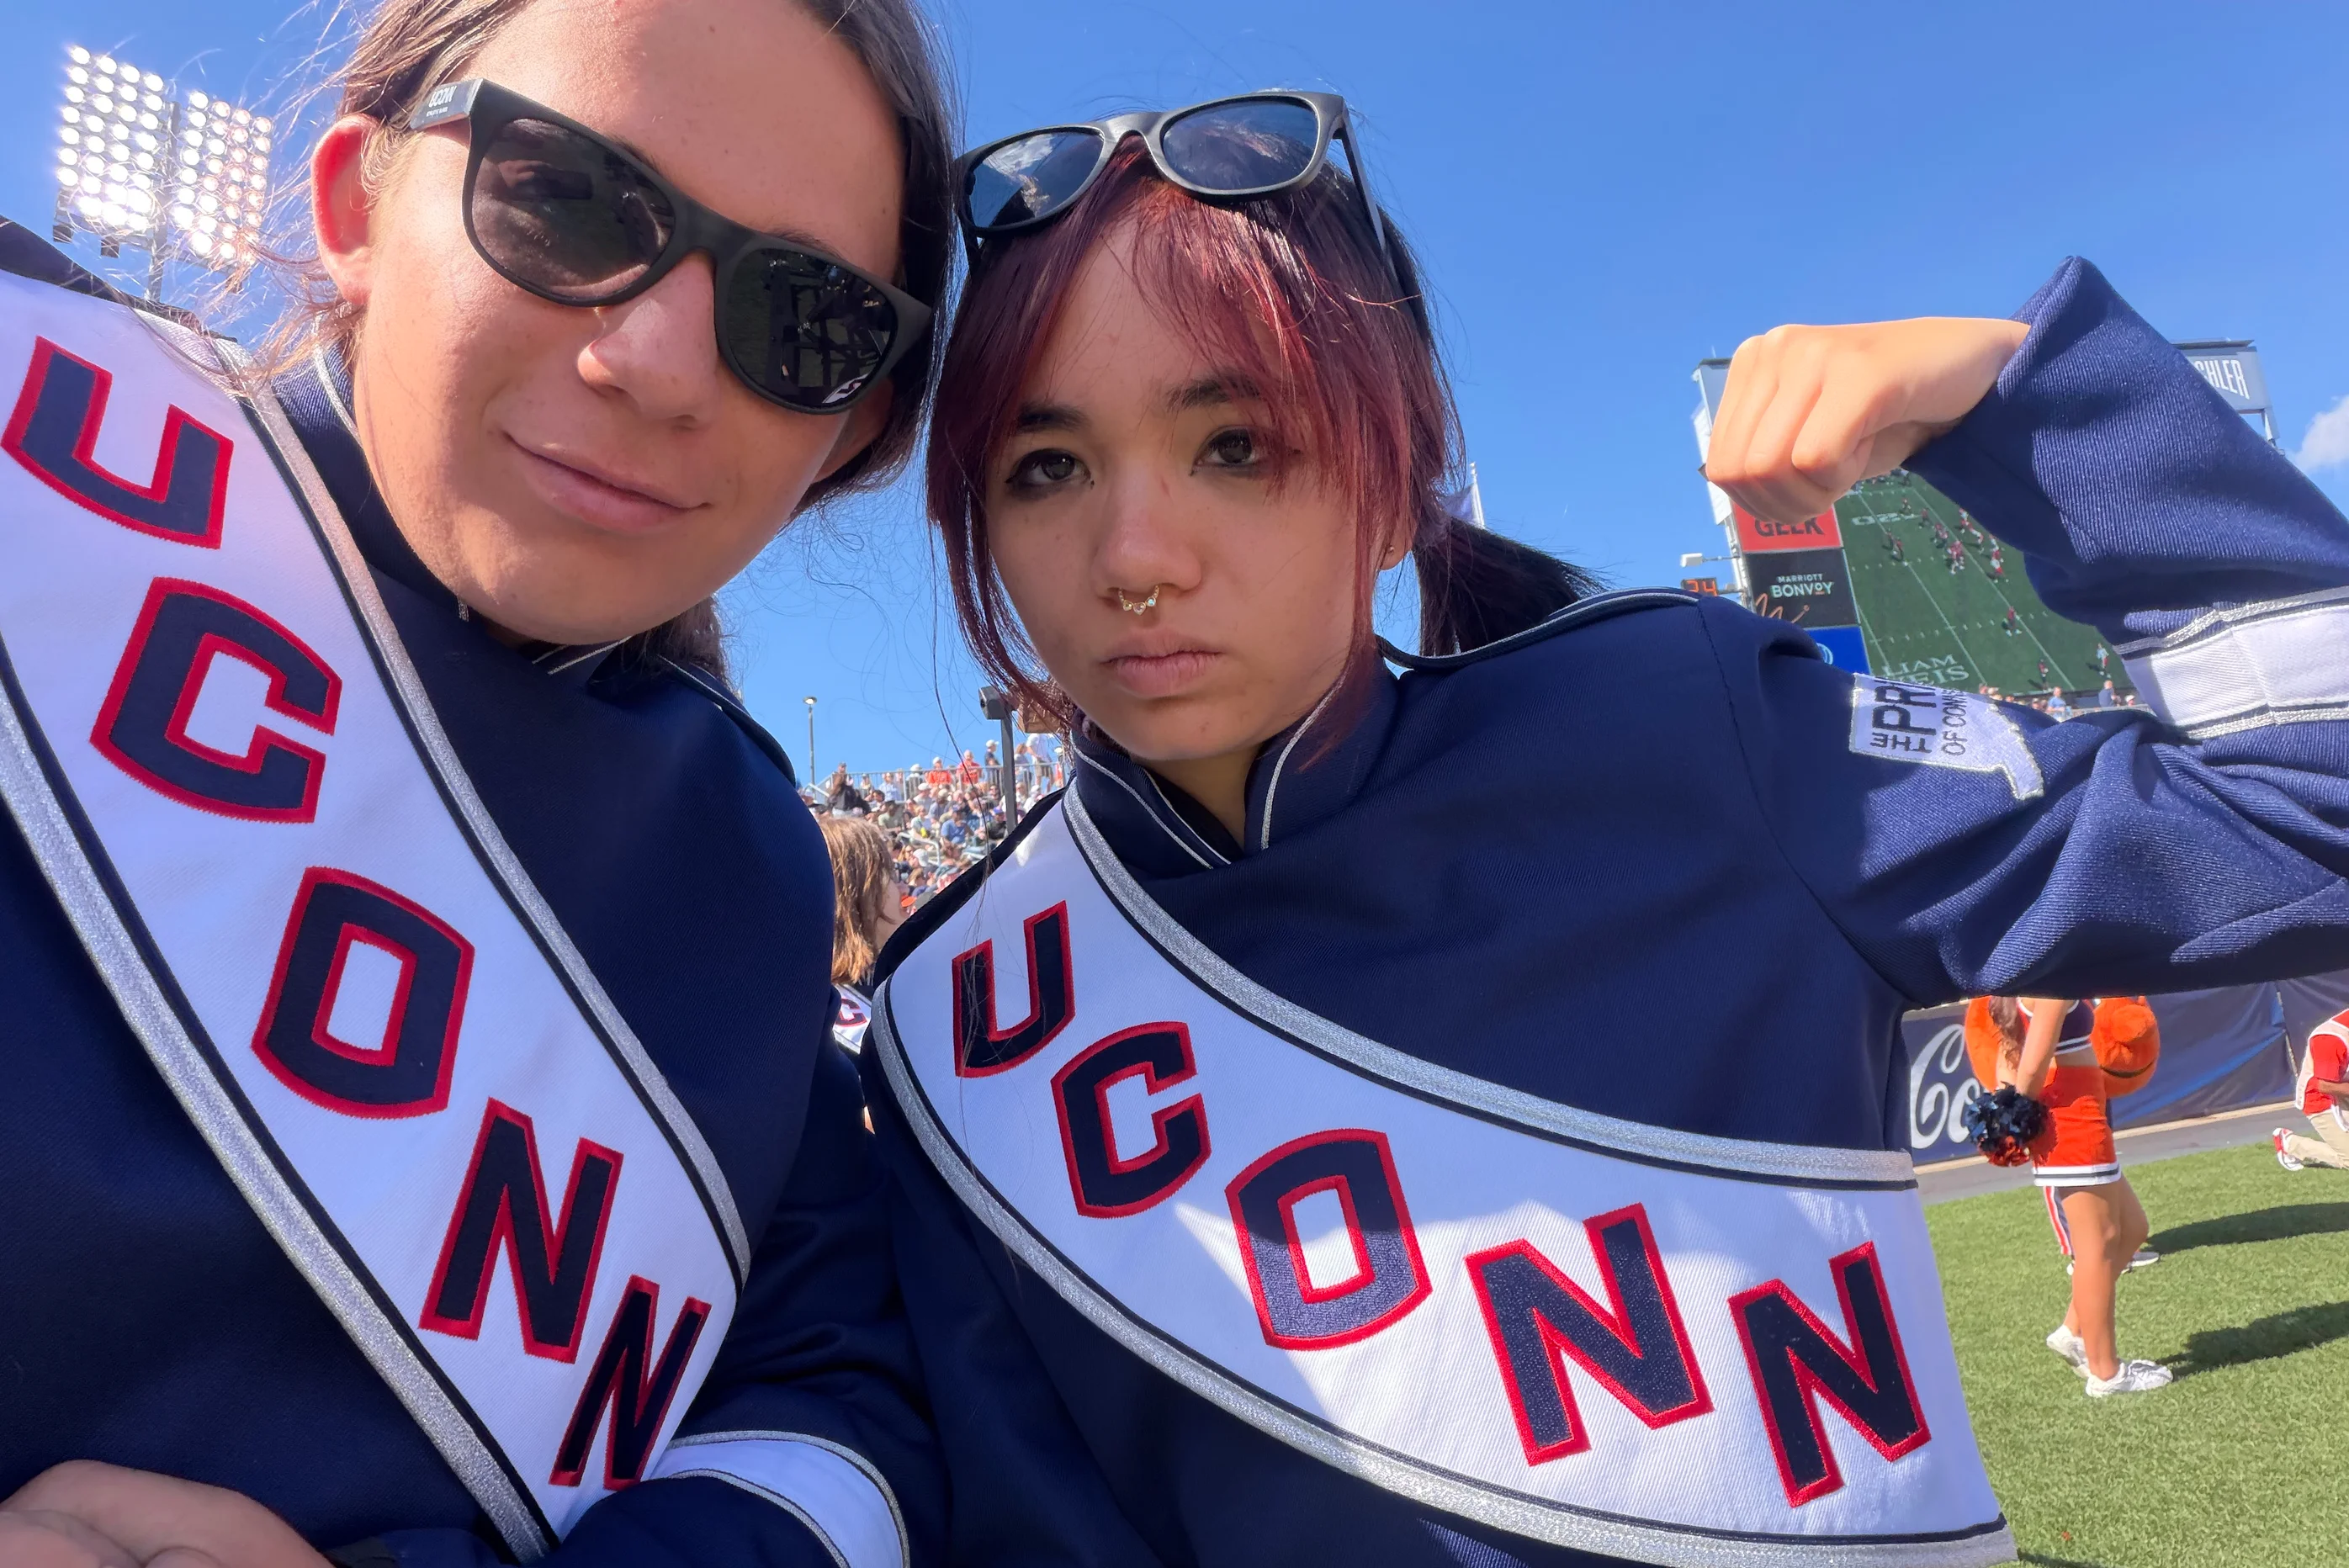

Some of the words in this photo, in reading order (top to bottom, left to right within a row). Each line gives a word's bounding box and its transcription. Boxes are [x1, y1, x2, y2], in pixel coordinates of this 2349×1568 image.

[1771, 582, 1832, 598] BONVOY
[1778, 574, 1823, 583] MARRIOTT
[1898, 665, 1970, 686] EIS
[1942, 690, 1968, 728] CONN
[1869, 732, 1933, 754] THE
[1941, 730, 1968, 755] OF
[2, 336, 710, 1490] UCONN
[952, 900, 1932, 1507] UCONN
